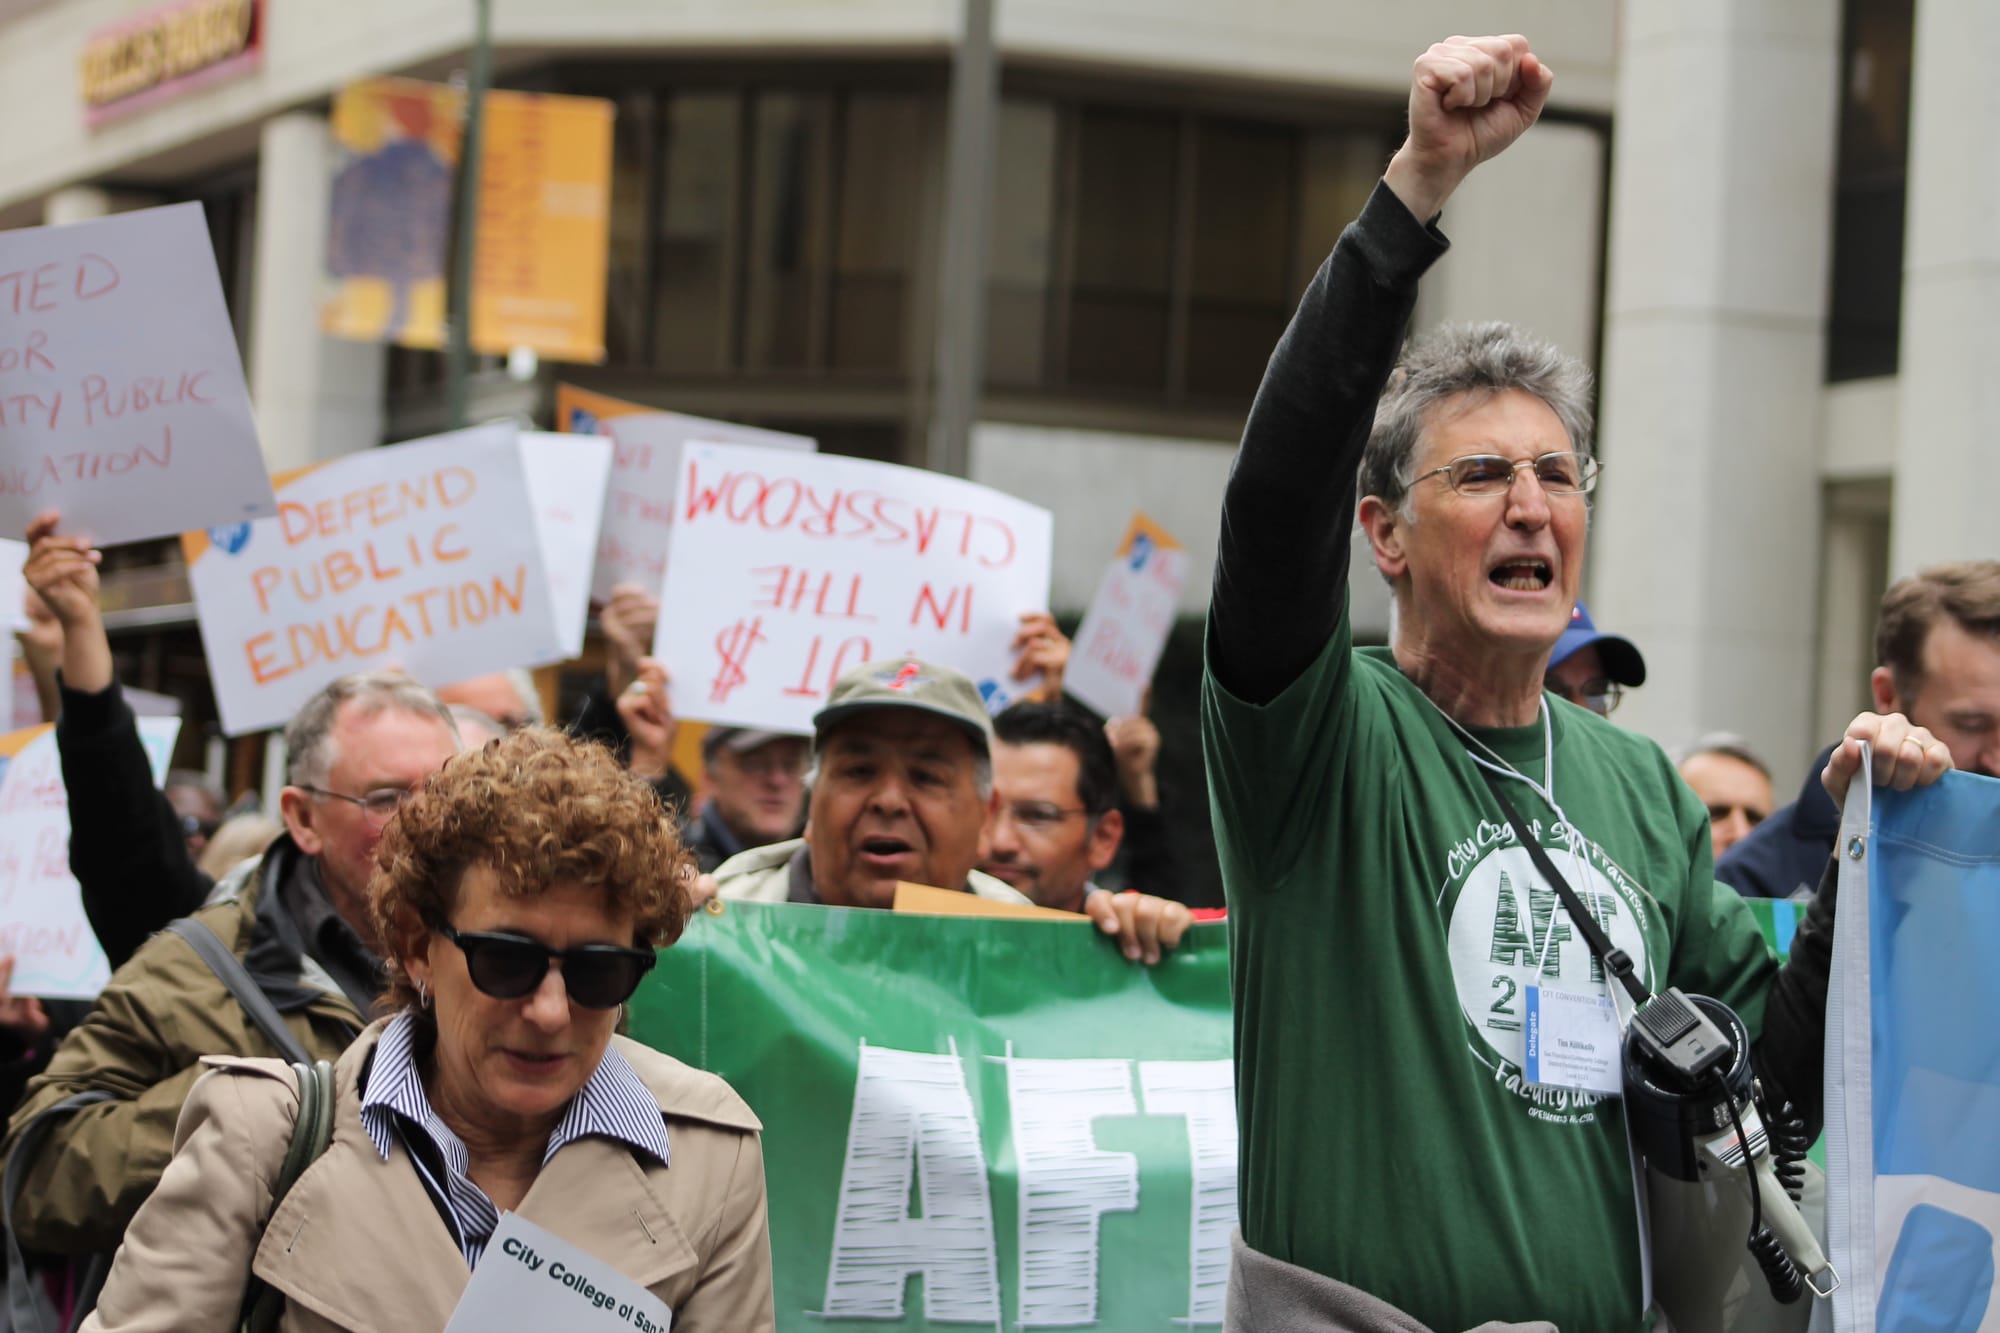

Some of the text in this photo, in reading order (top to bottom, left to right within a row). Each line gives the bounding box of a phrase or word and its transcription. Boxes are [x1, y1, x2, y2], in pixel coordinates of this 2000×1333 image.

[0, 252, 120, 316] TED
[0, 330, 55, 373] OR
[82, 370, 214, 427] PUBLIC
[278, 466, 477, 546] DEFEND
[685, 460, 1017, 569] CLASSROOM
[252, 523, 471, 615] PUBLIC
[751, 564, 975, 635] IN THE
[244, 564, 527, 687] EDUCATION
[783, 632, 872, 698] UT
[1447, 836, 1479, 880] City
[1528, 1010, 1538, 1057] Delegate
[502, 1236, 545, 1272] City
[548, 1261, 616, 1311] College
